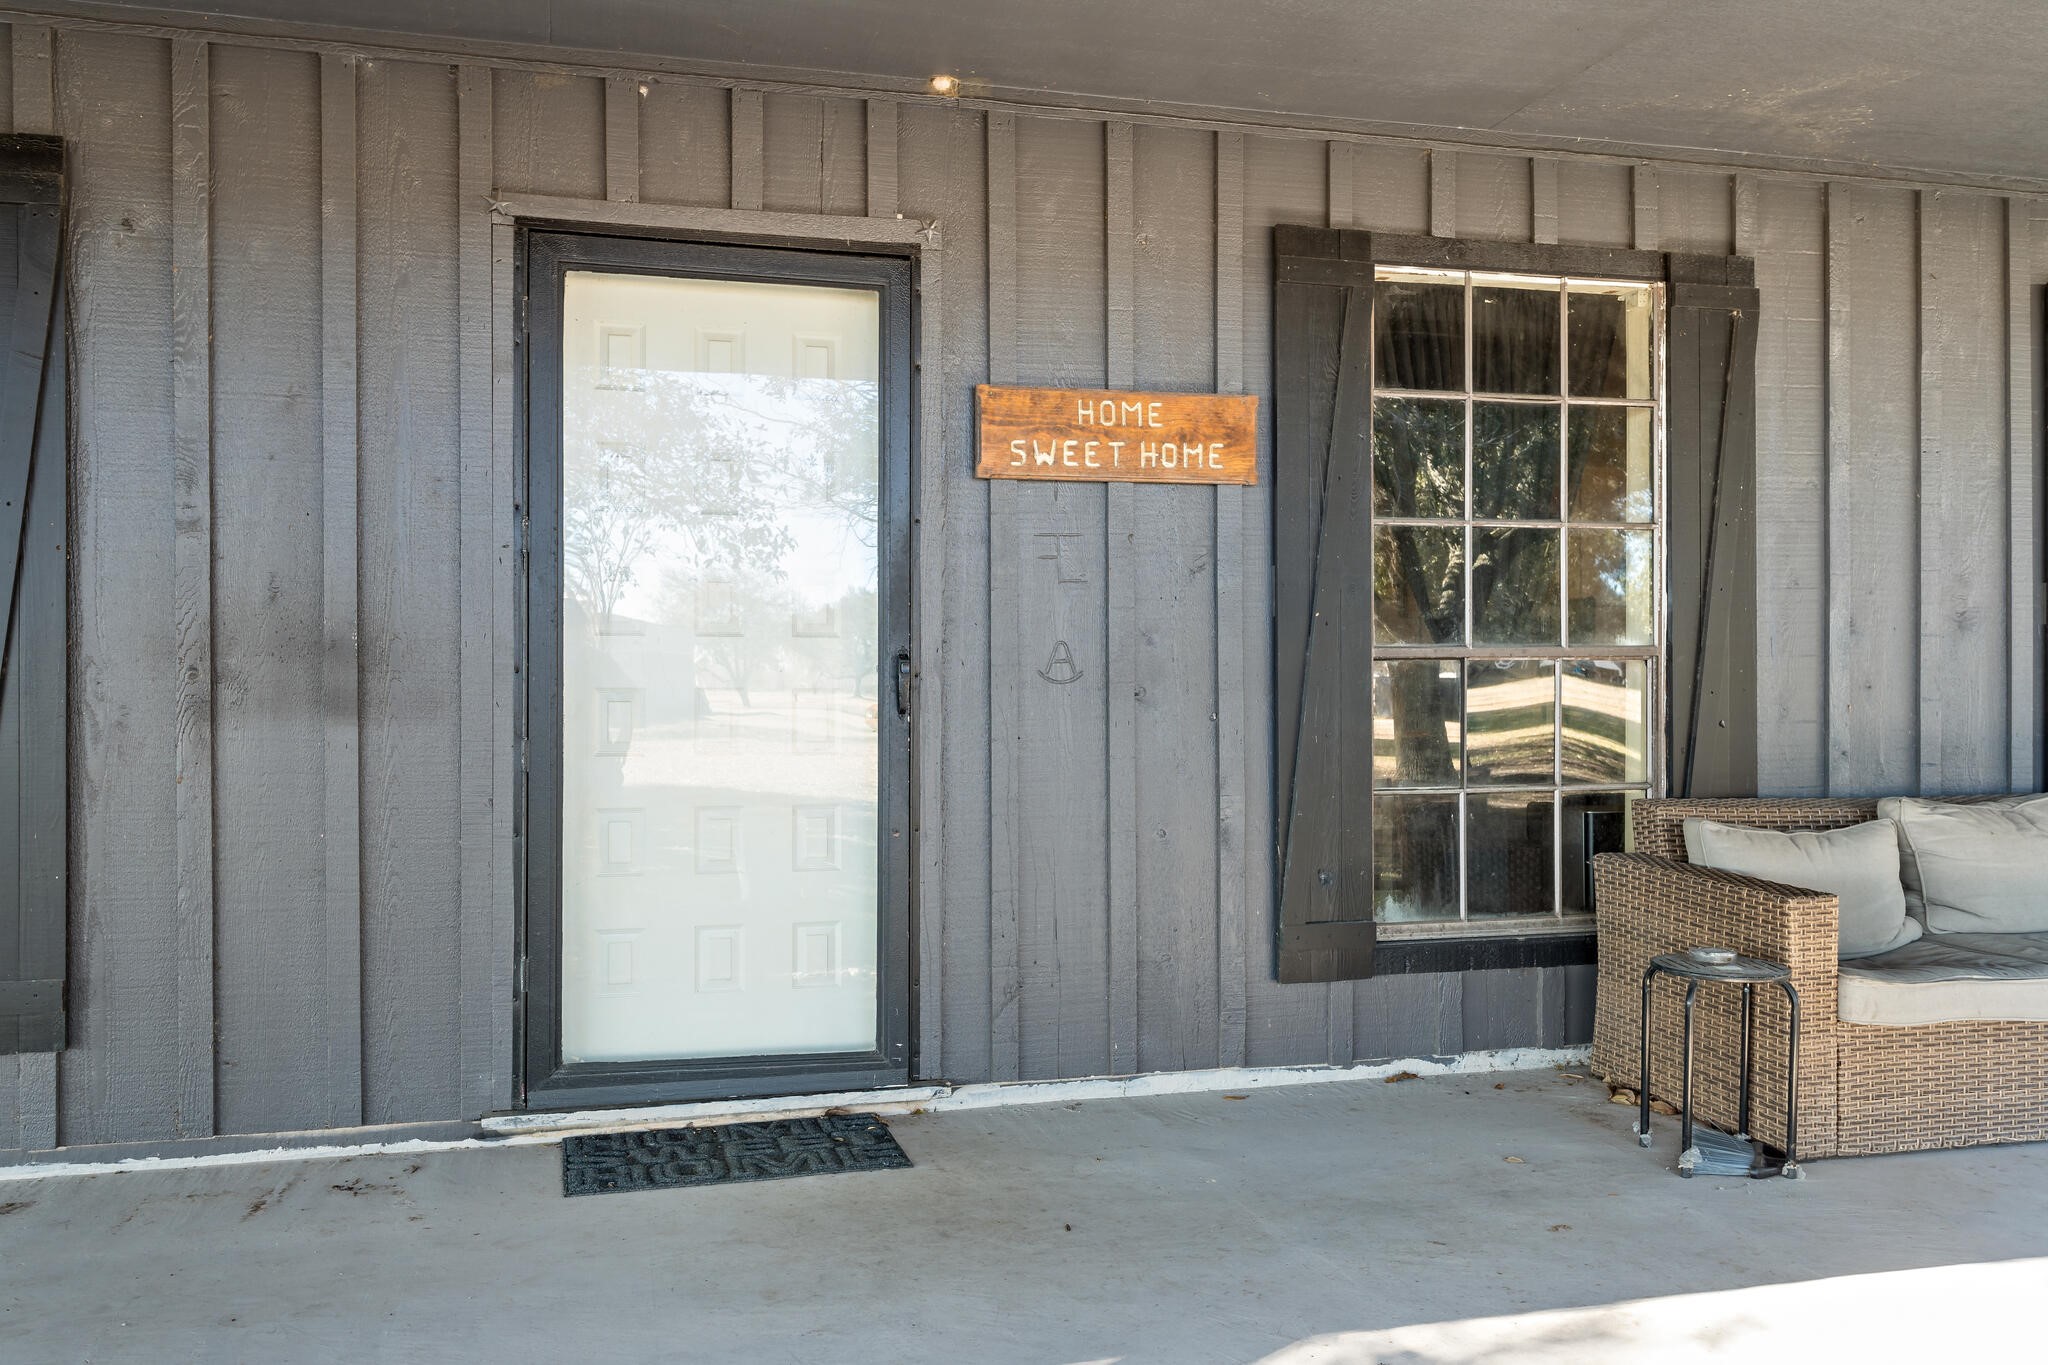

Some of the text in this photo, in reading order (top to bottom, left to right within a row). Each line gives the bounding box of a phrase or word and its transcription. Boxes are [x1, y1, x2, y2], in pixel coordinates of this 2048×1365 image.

[1078, 400, 1163, 428] HOME
[1010, 439, 1225, 471] SWEET HOME
[564, 1141, 908, 1192] HOME
